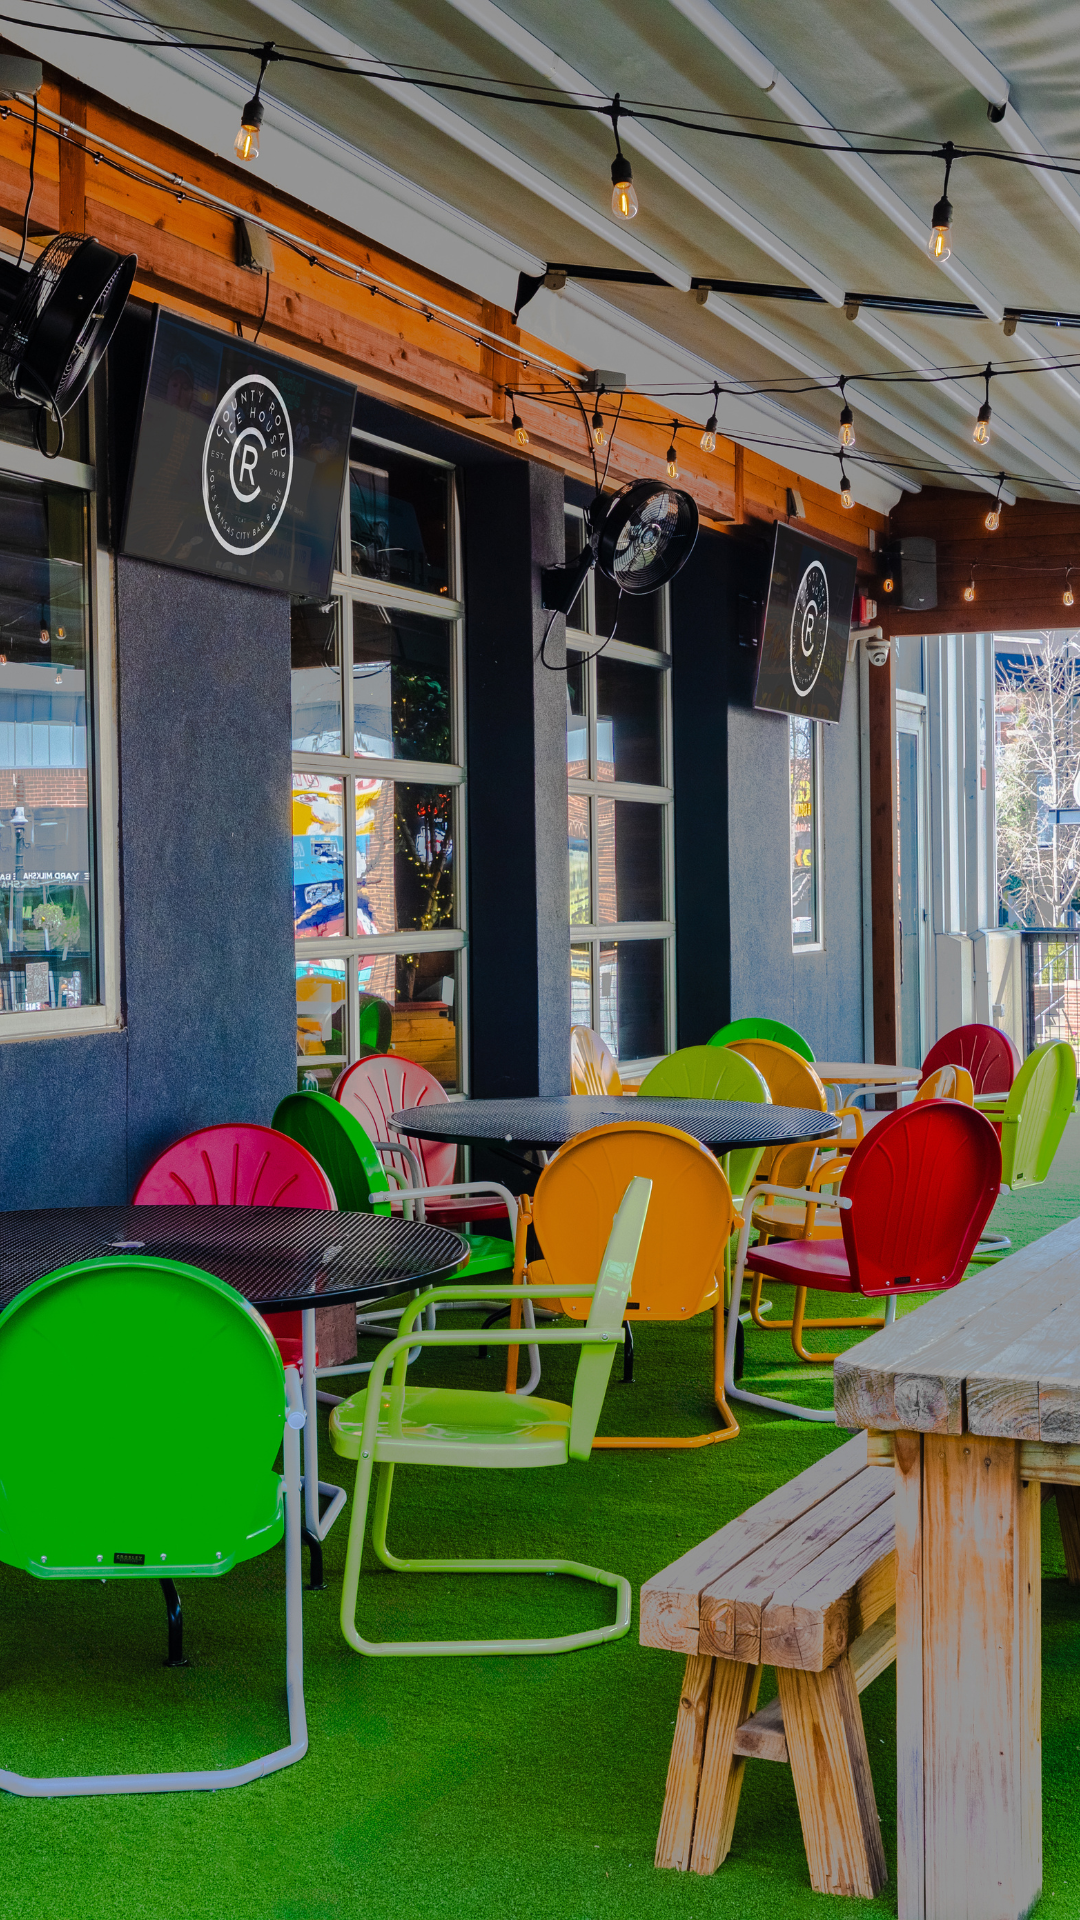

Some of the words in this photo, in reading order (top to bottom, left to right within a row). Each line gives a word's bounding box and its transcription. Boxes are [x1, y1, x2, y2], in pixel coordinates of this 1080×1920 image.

[216, 390, 264, 438] COUNTY
[268, 401, 287, 458] ROAD
[224, 412, 242, 444] ICE
[249, 406, 279, 459] HOUSE
[211, 450, 226, 461] EST.
[269, 468, 286, 479] 2018
[214, 504, 234, 537] KANSAS
[235, 530, 251, 540] CITY
